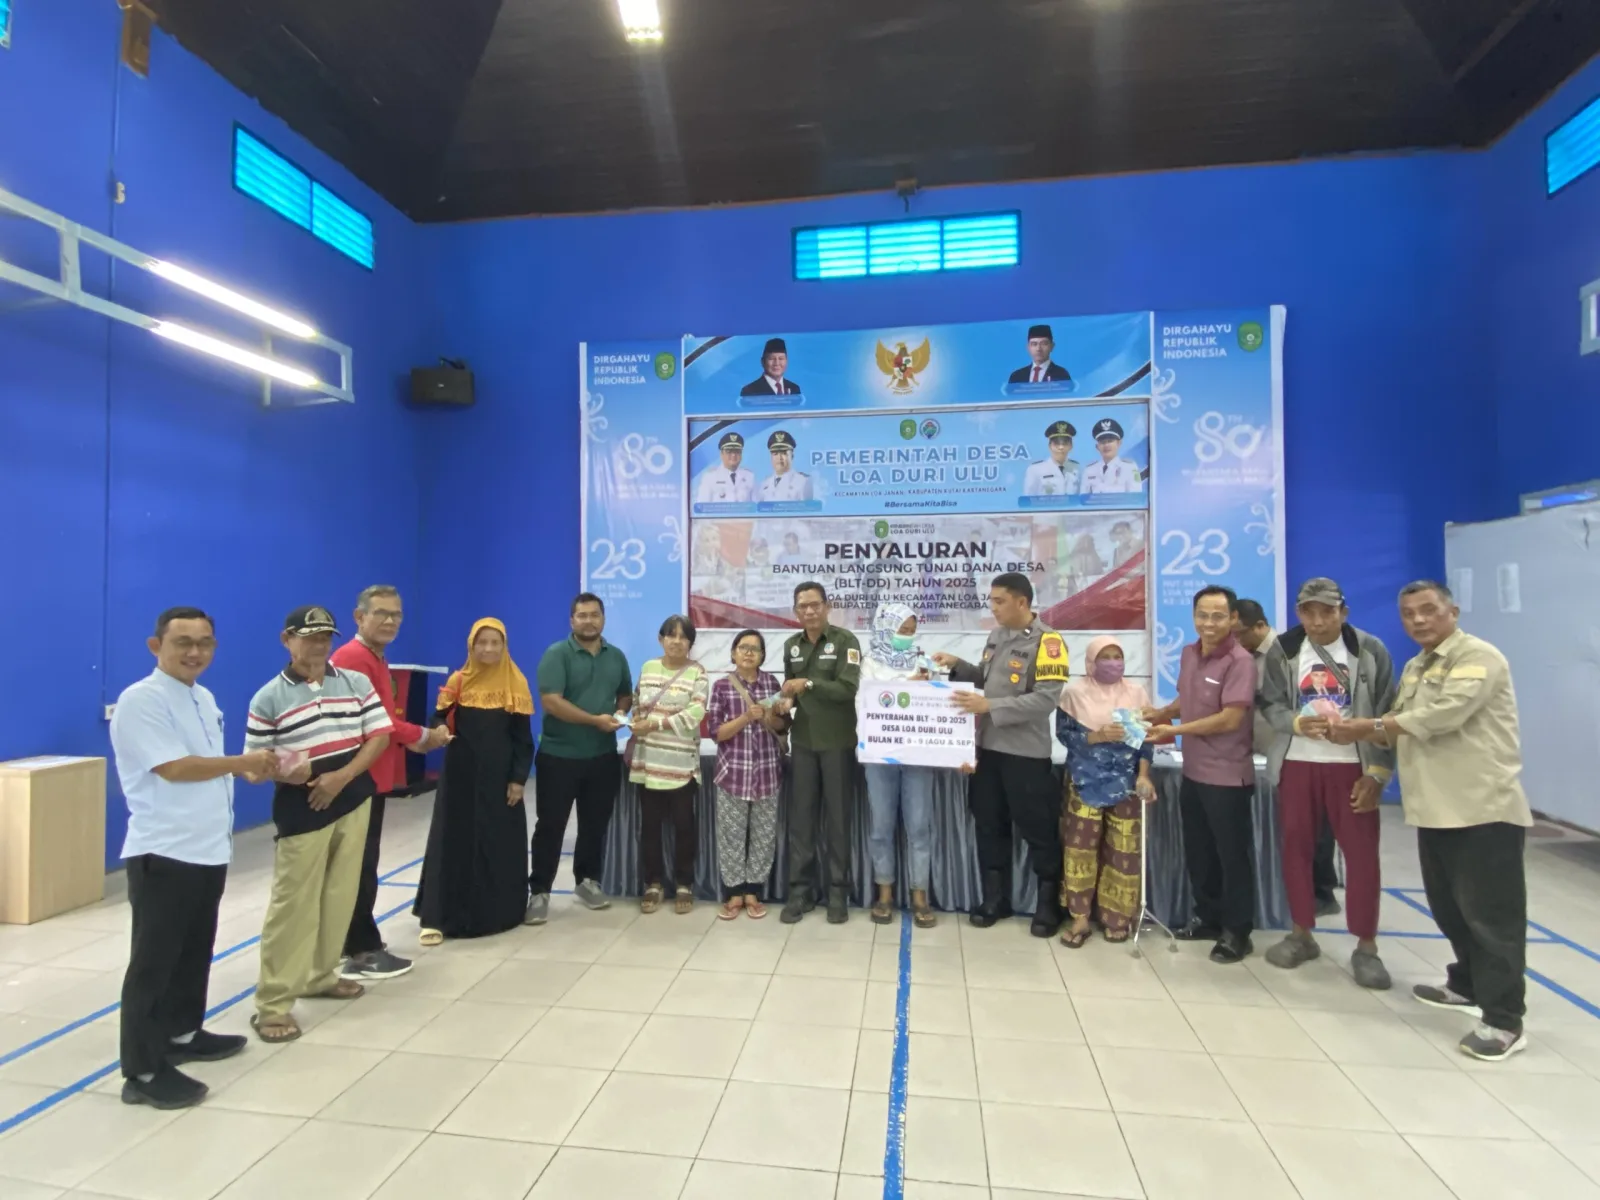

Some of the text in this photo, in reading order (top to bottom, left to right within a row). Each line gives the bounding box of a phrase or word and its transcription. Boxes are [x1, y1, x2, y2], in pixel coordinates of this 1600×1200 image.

[1163, 324, 1232, 336] DIRGAHAYU
[1163, 337, 1217, 347] REPUBLIK
[593, 354, 651, 364] DIRGAHAYU
[1163, 348, 1227, 359] INDONESIA
[594, 365, 638, 374] REPUBLIK
[594, 376, 646, 385] INDONESIA
[1194, 410, 1263, 462] 80
[618, 432, 674, 479] 80
[810, 444, 1030, 466] PEMERINTAH DESA
[838, 465, 998, 485] LOA DURI ULU
[884, 500, 958, 508] #BersamaKitaBisa
[824, 541, 987, 560] PENYALURAN
[1160, 529, 1231, 575] 23
[590, 538, 647, 580] 23
[772, 562, 1045, 574] BANTUAN LANGSUNG TUNAI DANA DESA
[834, 577, 977, 590] (BLT-DD) TAHUN 2025
[844, 593, 869, 601] DURI
[870, 593, 891, 601] ULU
[893, 593, 956, 601] KECAMATAN
[958, 593, 979, 601] LOA
[913, 601, 989, 610] KARTANEGARA
[866, 712, 915, 722] PENYERAHAN
[916, 714, 929, 723] BLT
[936, 715, 948, 724] DD
[949, 716, 967, 725] 2025
[881, 724, 953, 735] DESA LOA DURI ULU
[867, 735, 892, 744] BULAN
[894, 736, 904, 744] KE
